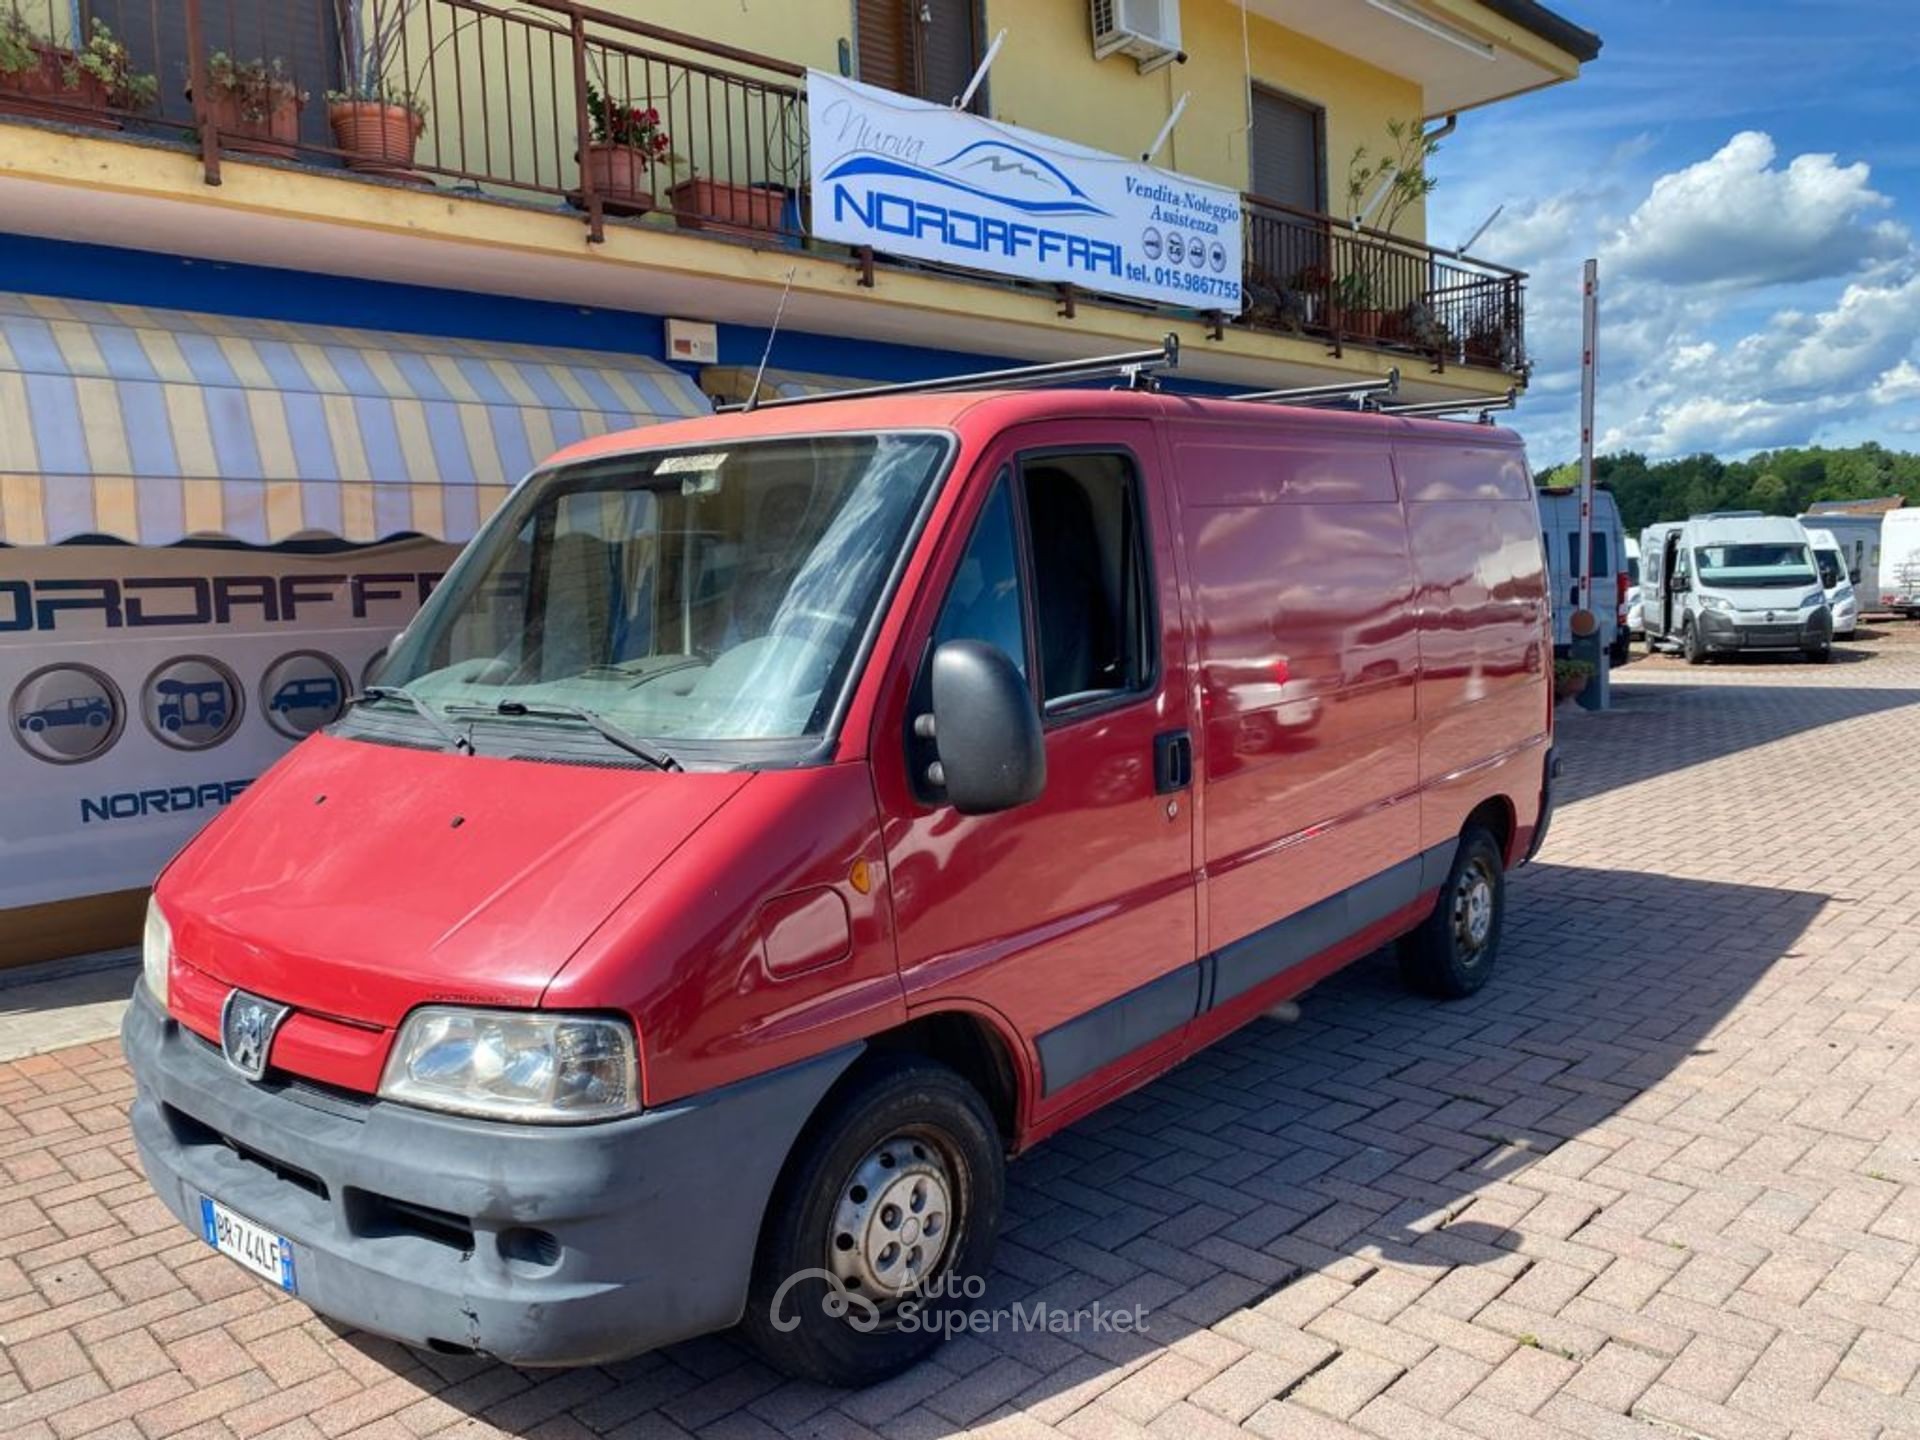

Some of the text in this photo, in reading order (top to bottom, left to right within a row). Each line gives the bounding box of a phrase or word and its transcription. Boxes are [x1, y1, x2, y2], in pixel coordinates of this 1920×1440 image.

[834, 183, 1123, 277] NORDAFFARI
[1150, 203, 1218, 235] Assistenza
[1125, 262, 1240, 300] tel. 015.9867755
